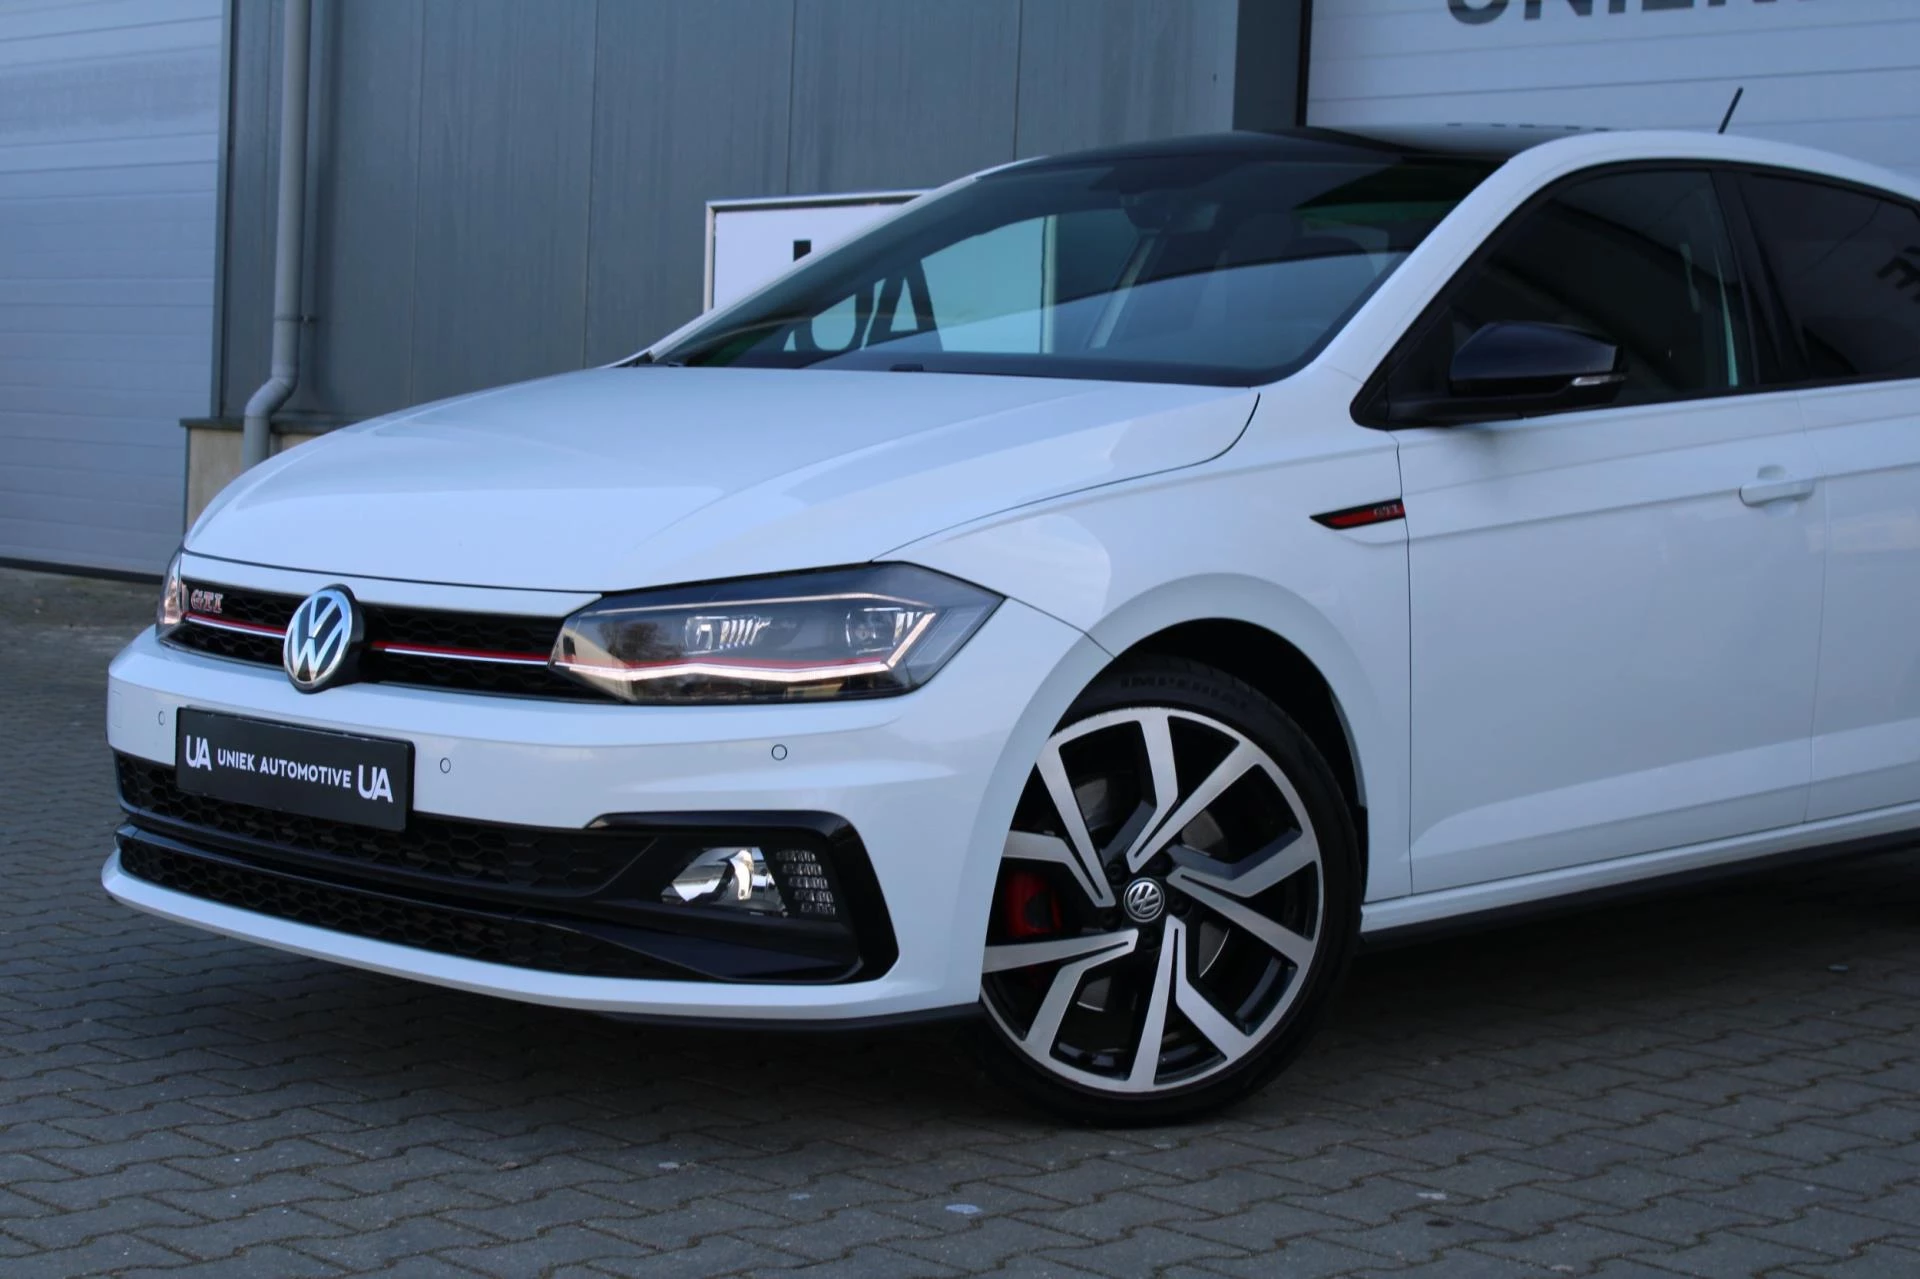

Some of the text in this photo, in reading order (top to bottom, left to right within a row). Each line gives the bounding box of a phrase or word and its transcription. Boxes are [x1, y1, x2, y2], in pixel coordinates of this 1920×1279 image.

[191, 589, 223, 613] GTI
[185, 734, 394, 803] UA UNIEK AUTOMOTIVE UA
